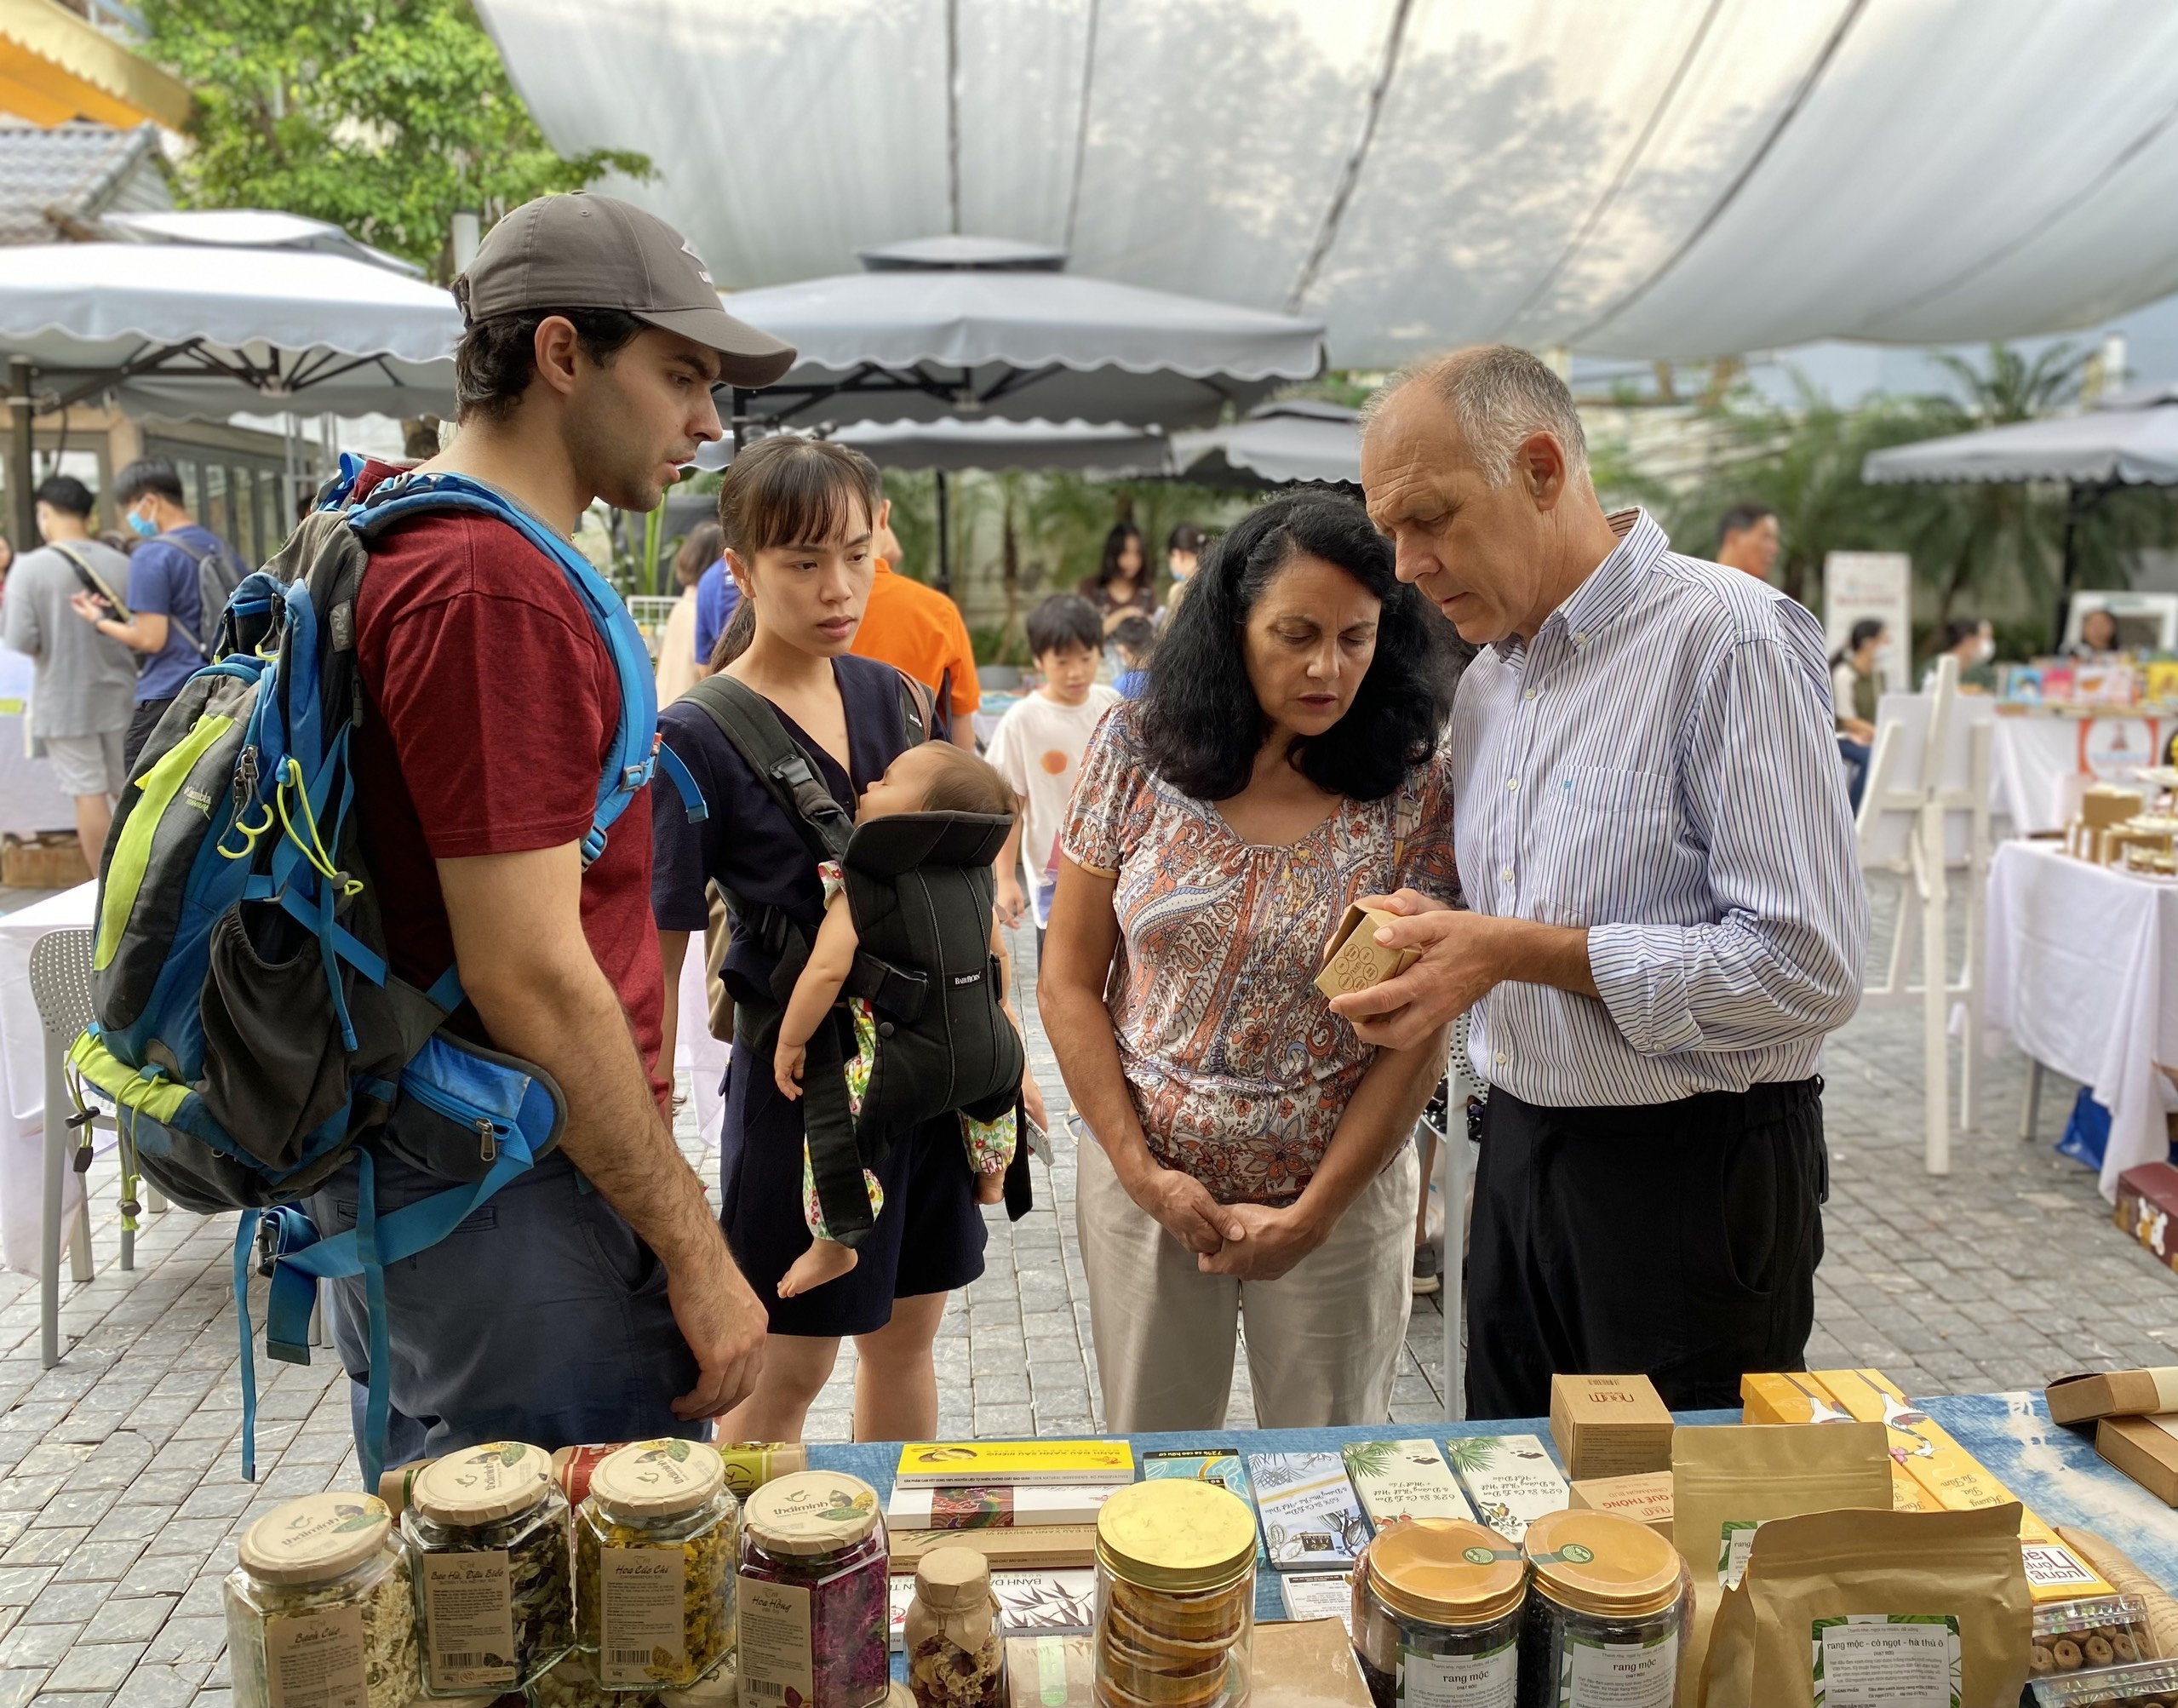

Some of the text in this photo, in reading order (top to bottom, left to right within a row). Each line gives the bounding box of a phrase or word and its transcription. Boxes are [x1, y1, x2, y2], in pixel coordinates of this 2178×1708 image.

[1006, 1577, 1042, 1587] BÁNH
[1827, 1642, 1846, 1650] rang
[1848, 1640, 1865, 1648] mộc
[1871, 1638, 1881, 1647] cỏ
[1883, 1638, 1900, 1648] ngọt
[1909, 1638, 1919, 1647] hà
[1613, 1659, 1657, 1672] rang mộc
[1442, 1671, 1489, 1684] rang mộc
